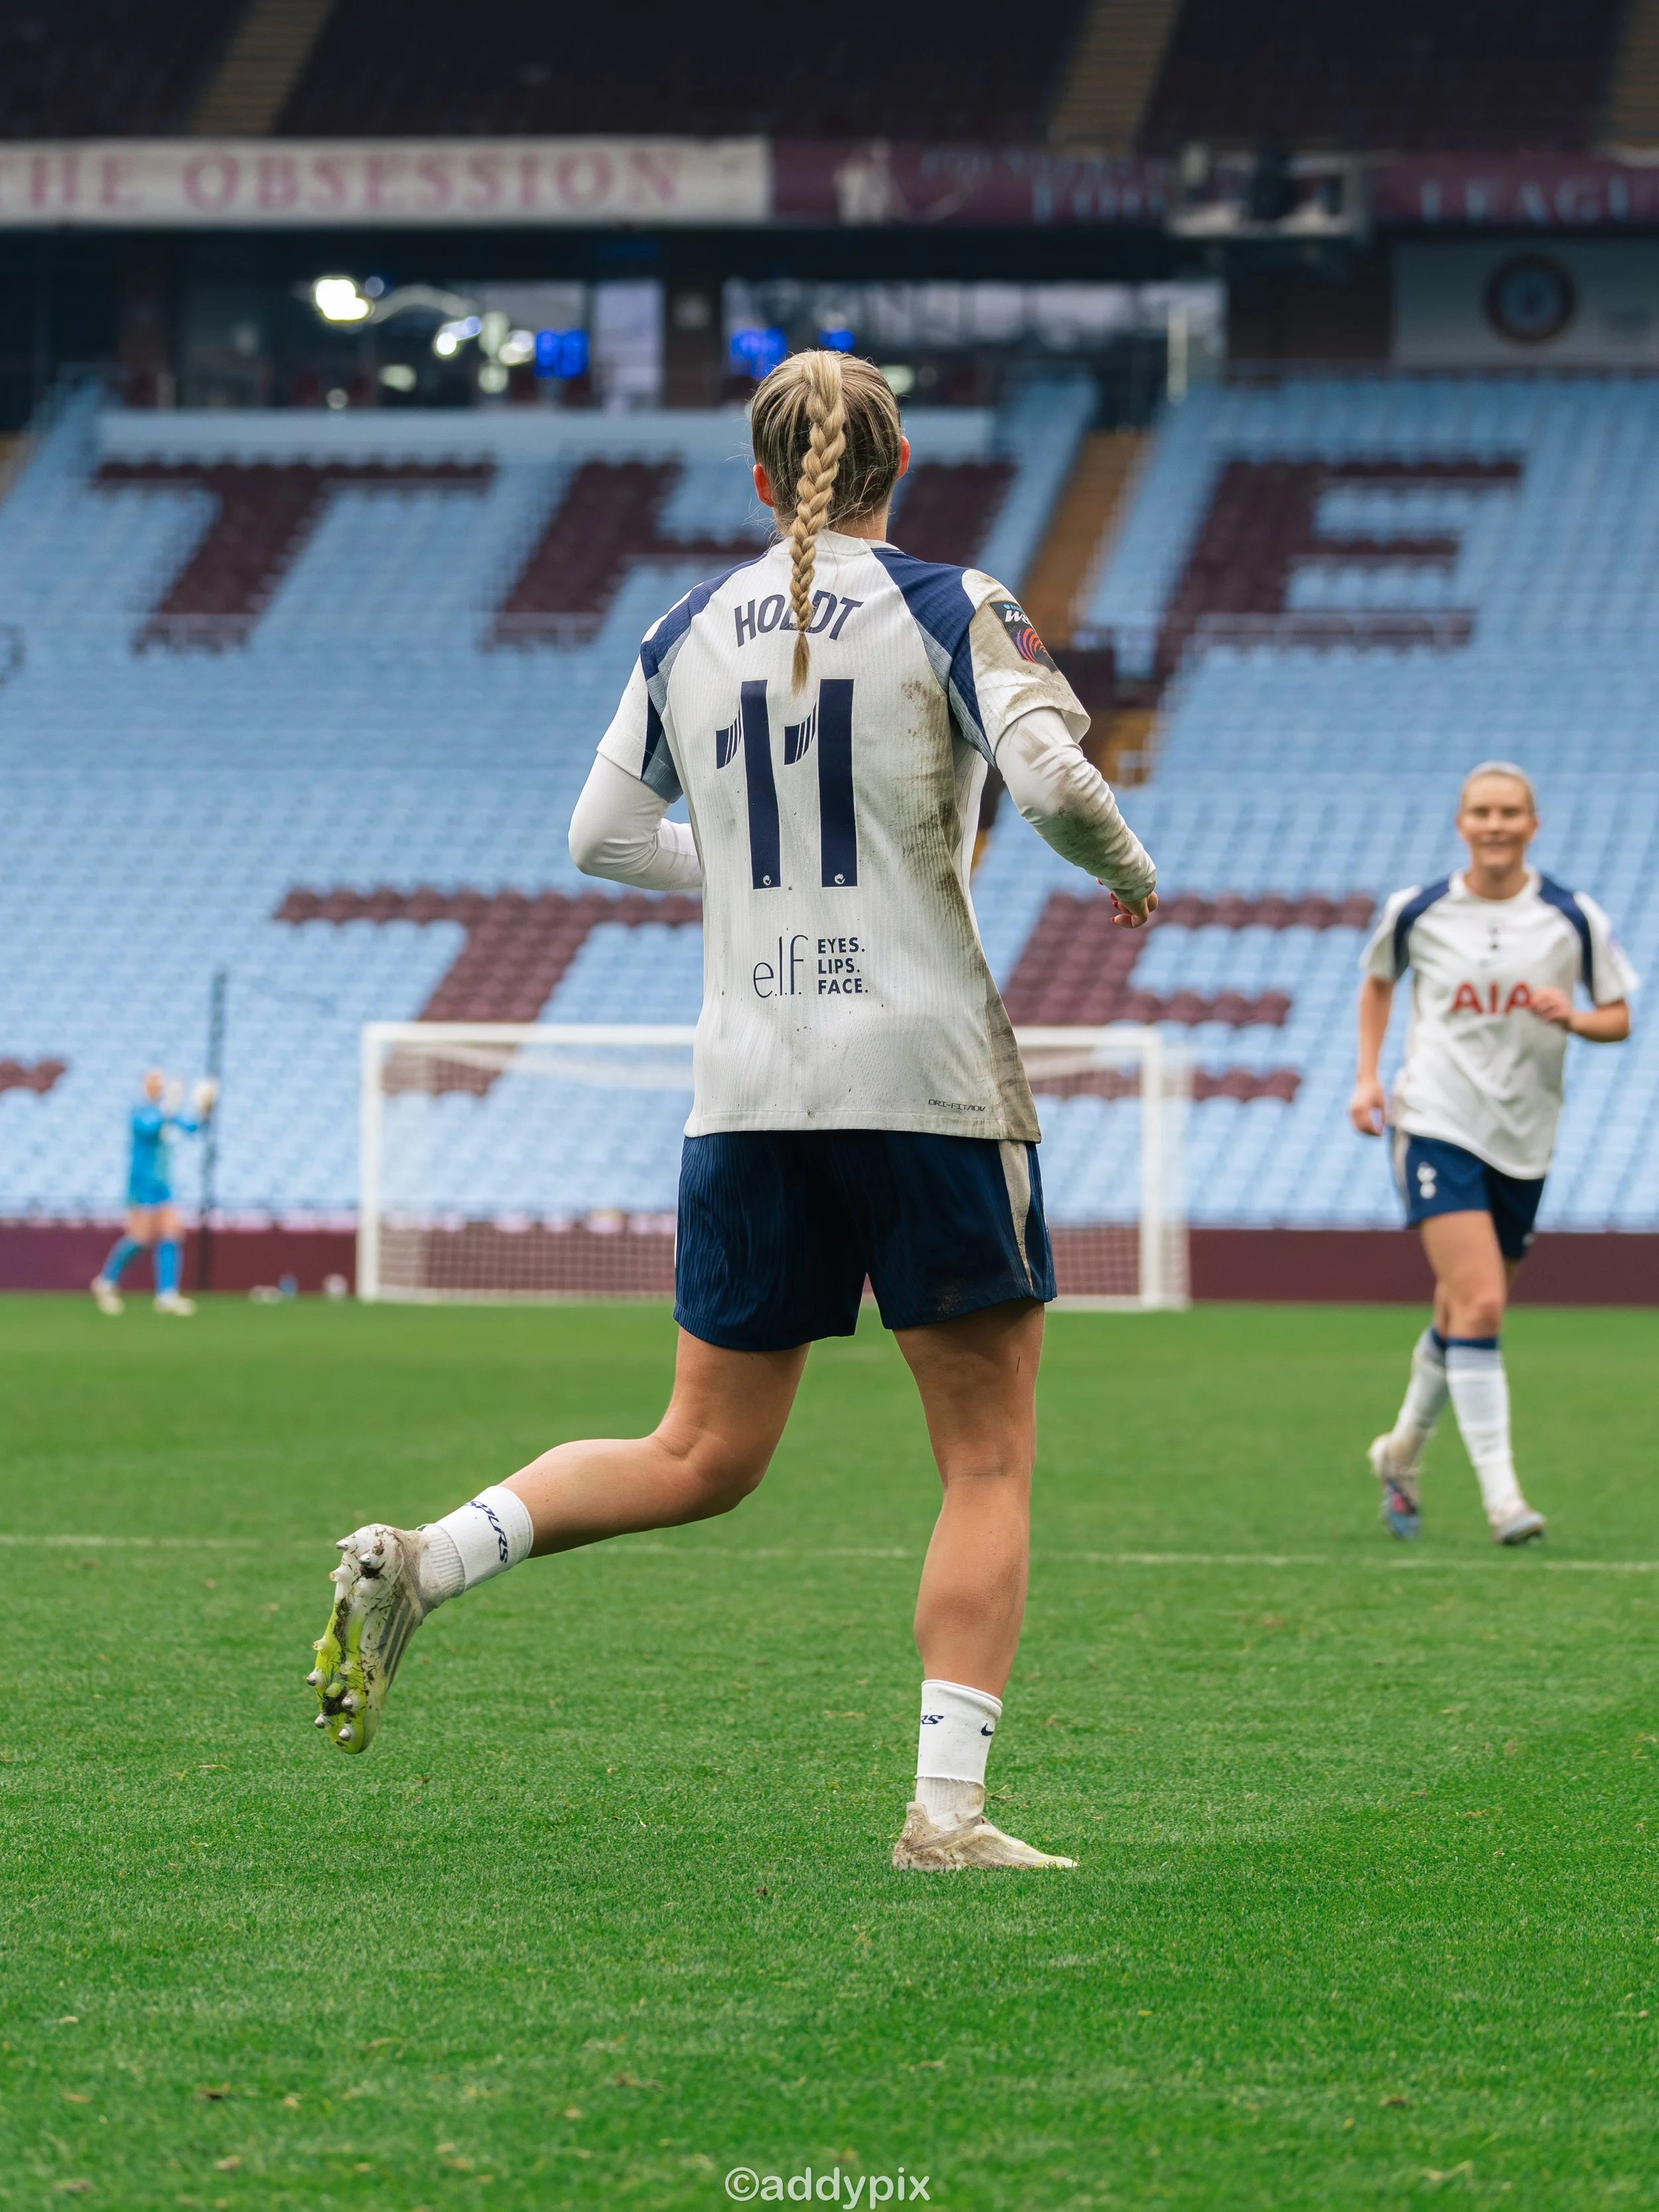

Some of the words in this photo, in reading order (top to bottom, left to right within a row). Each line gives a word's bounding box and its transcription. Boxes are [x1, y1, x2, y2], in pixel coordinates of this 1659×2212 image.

[180, 149, 680, 214] OBSESSION
[715, 679, 858, 890] 11
[817, 937, 865, 954] EYES.
[818, 957, 860, 975] LIPS.
[818, 978, 869, 995] FACE.
[1450, 981, 1533, 1015] AIA
